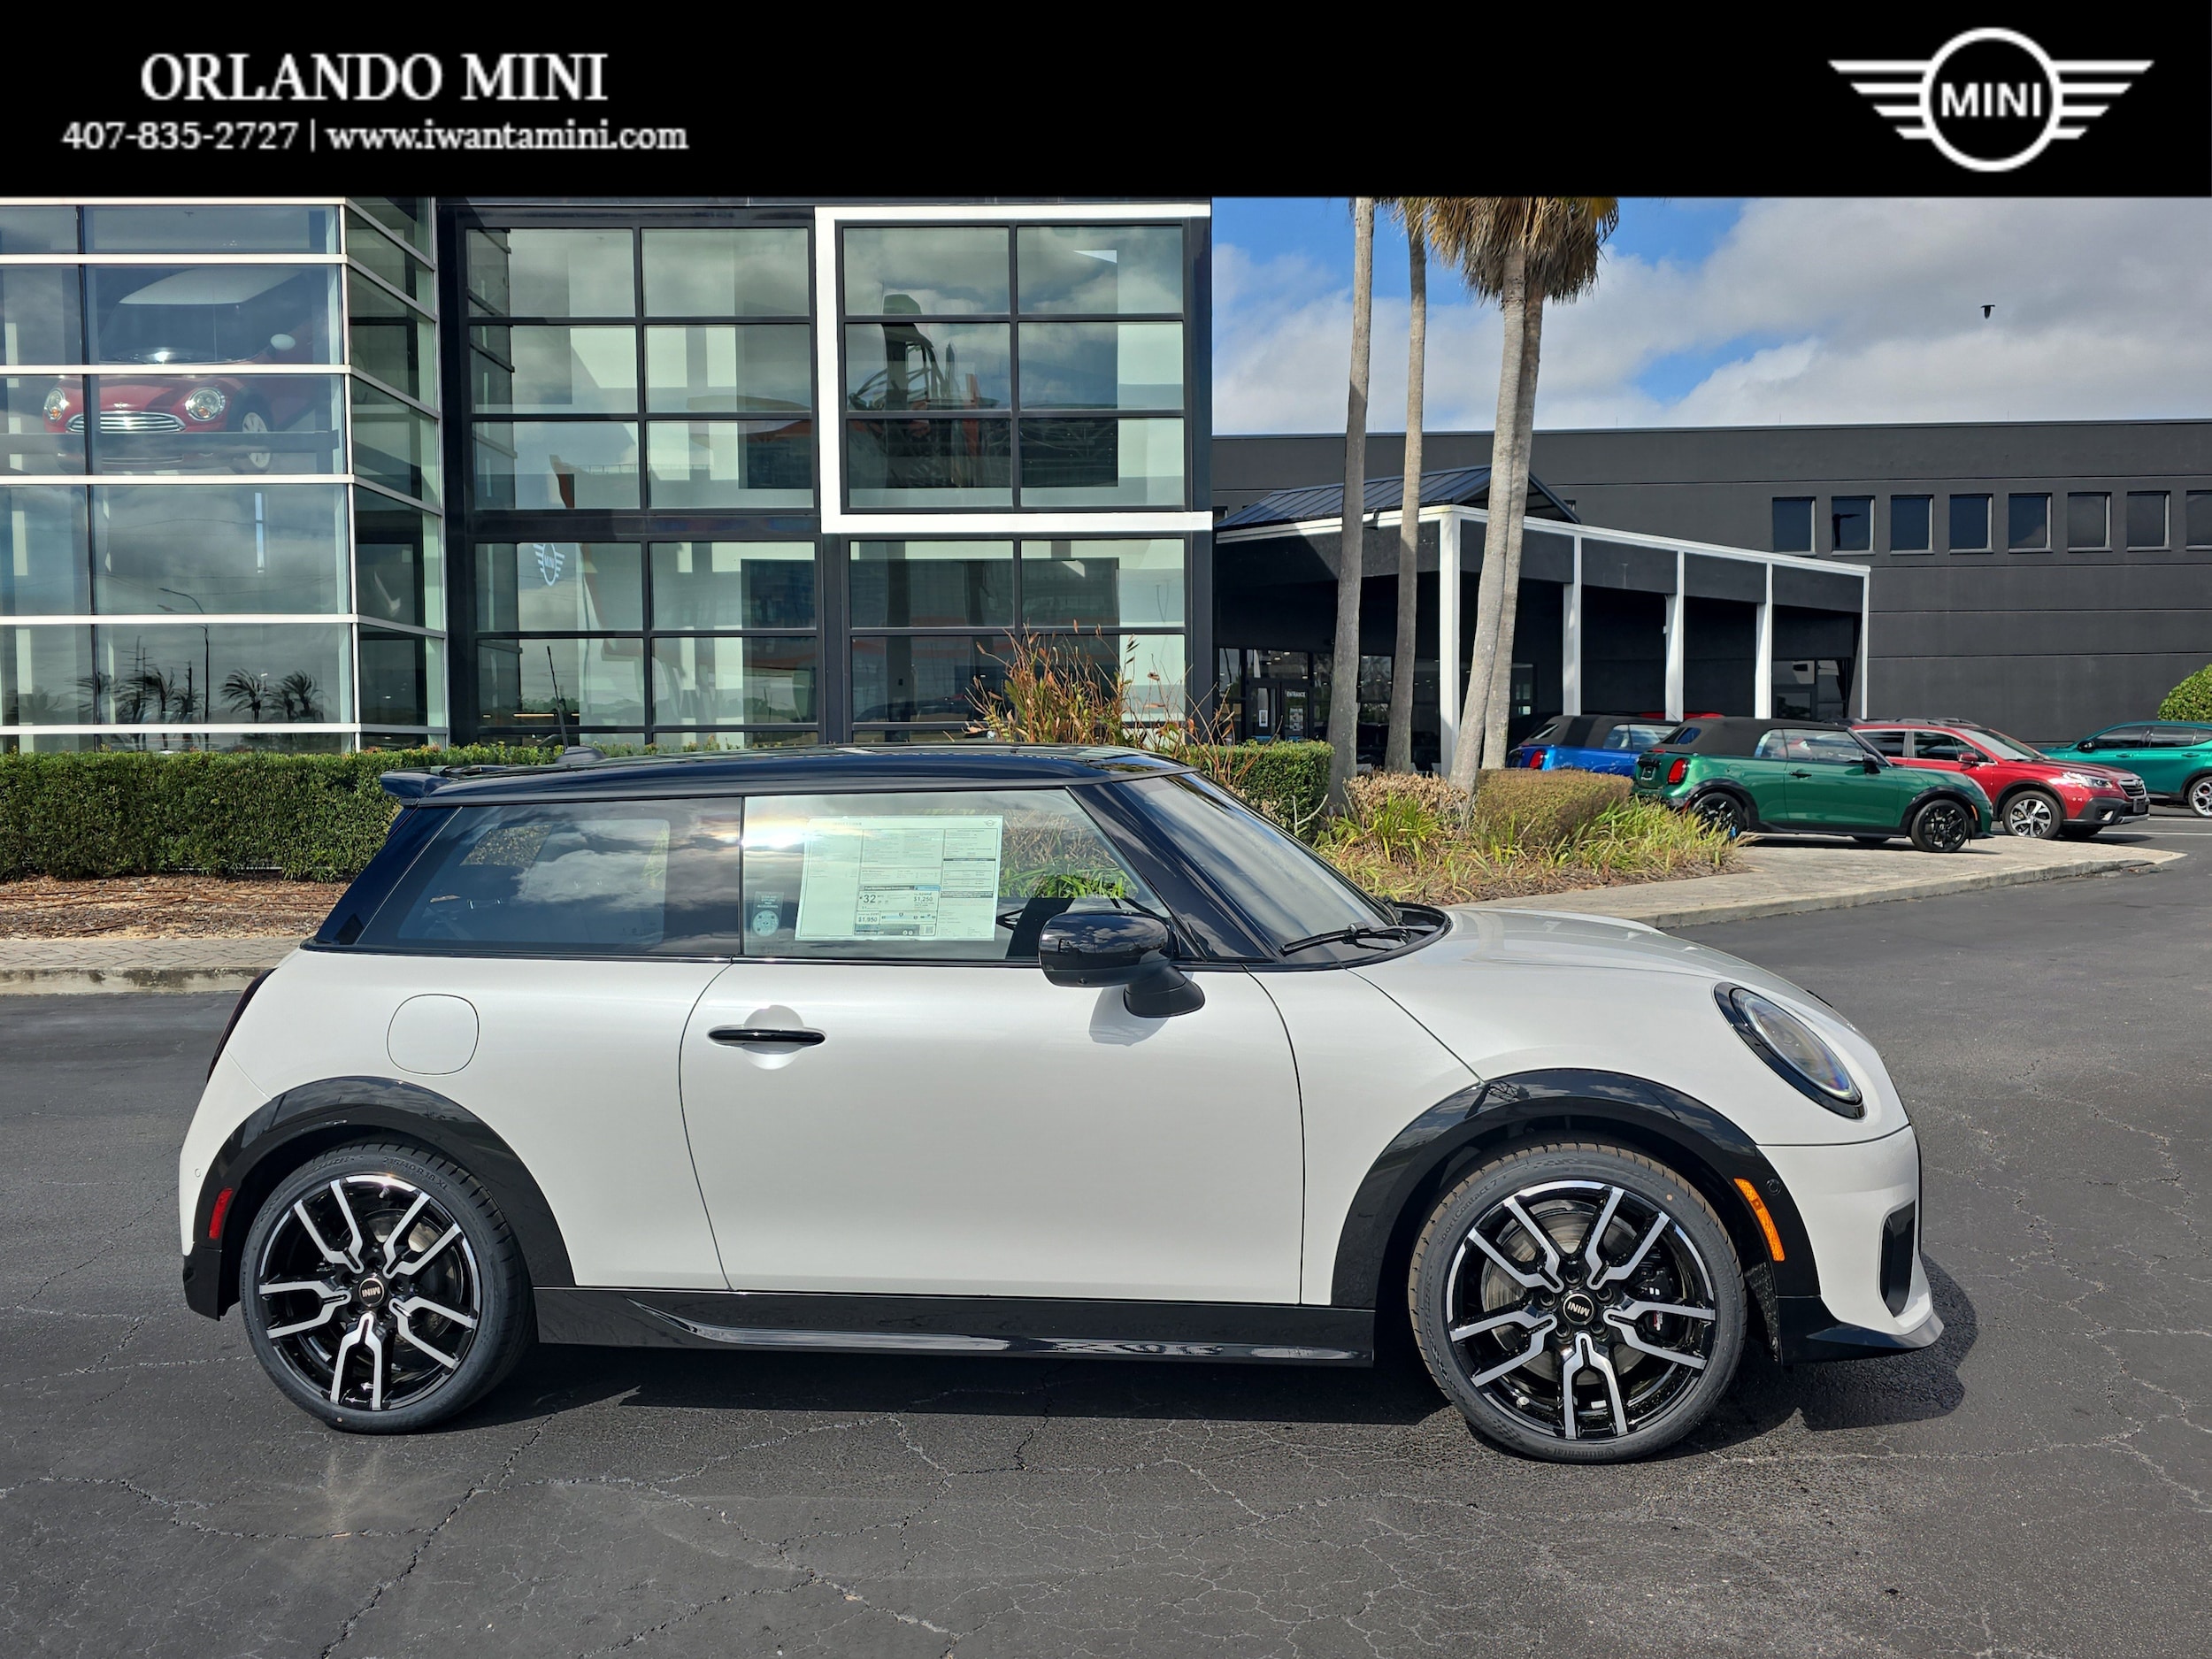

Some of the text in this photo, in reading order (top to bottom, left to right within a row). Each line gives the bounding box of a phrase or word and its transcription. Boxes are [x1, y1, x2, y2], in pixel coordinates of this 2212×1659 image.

[864, 894, 876, 903] 32
[1438, 1186, 1490, 1246] SportContact
[362, 1286, 380, 1298] MINI
[1567, 1302, 1590, 1317] MINI
